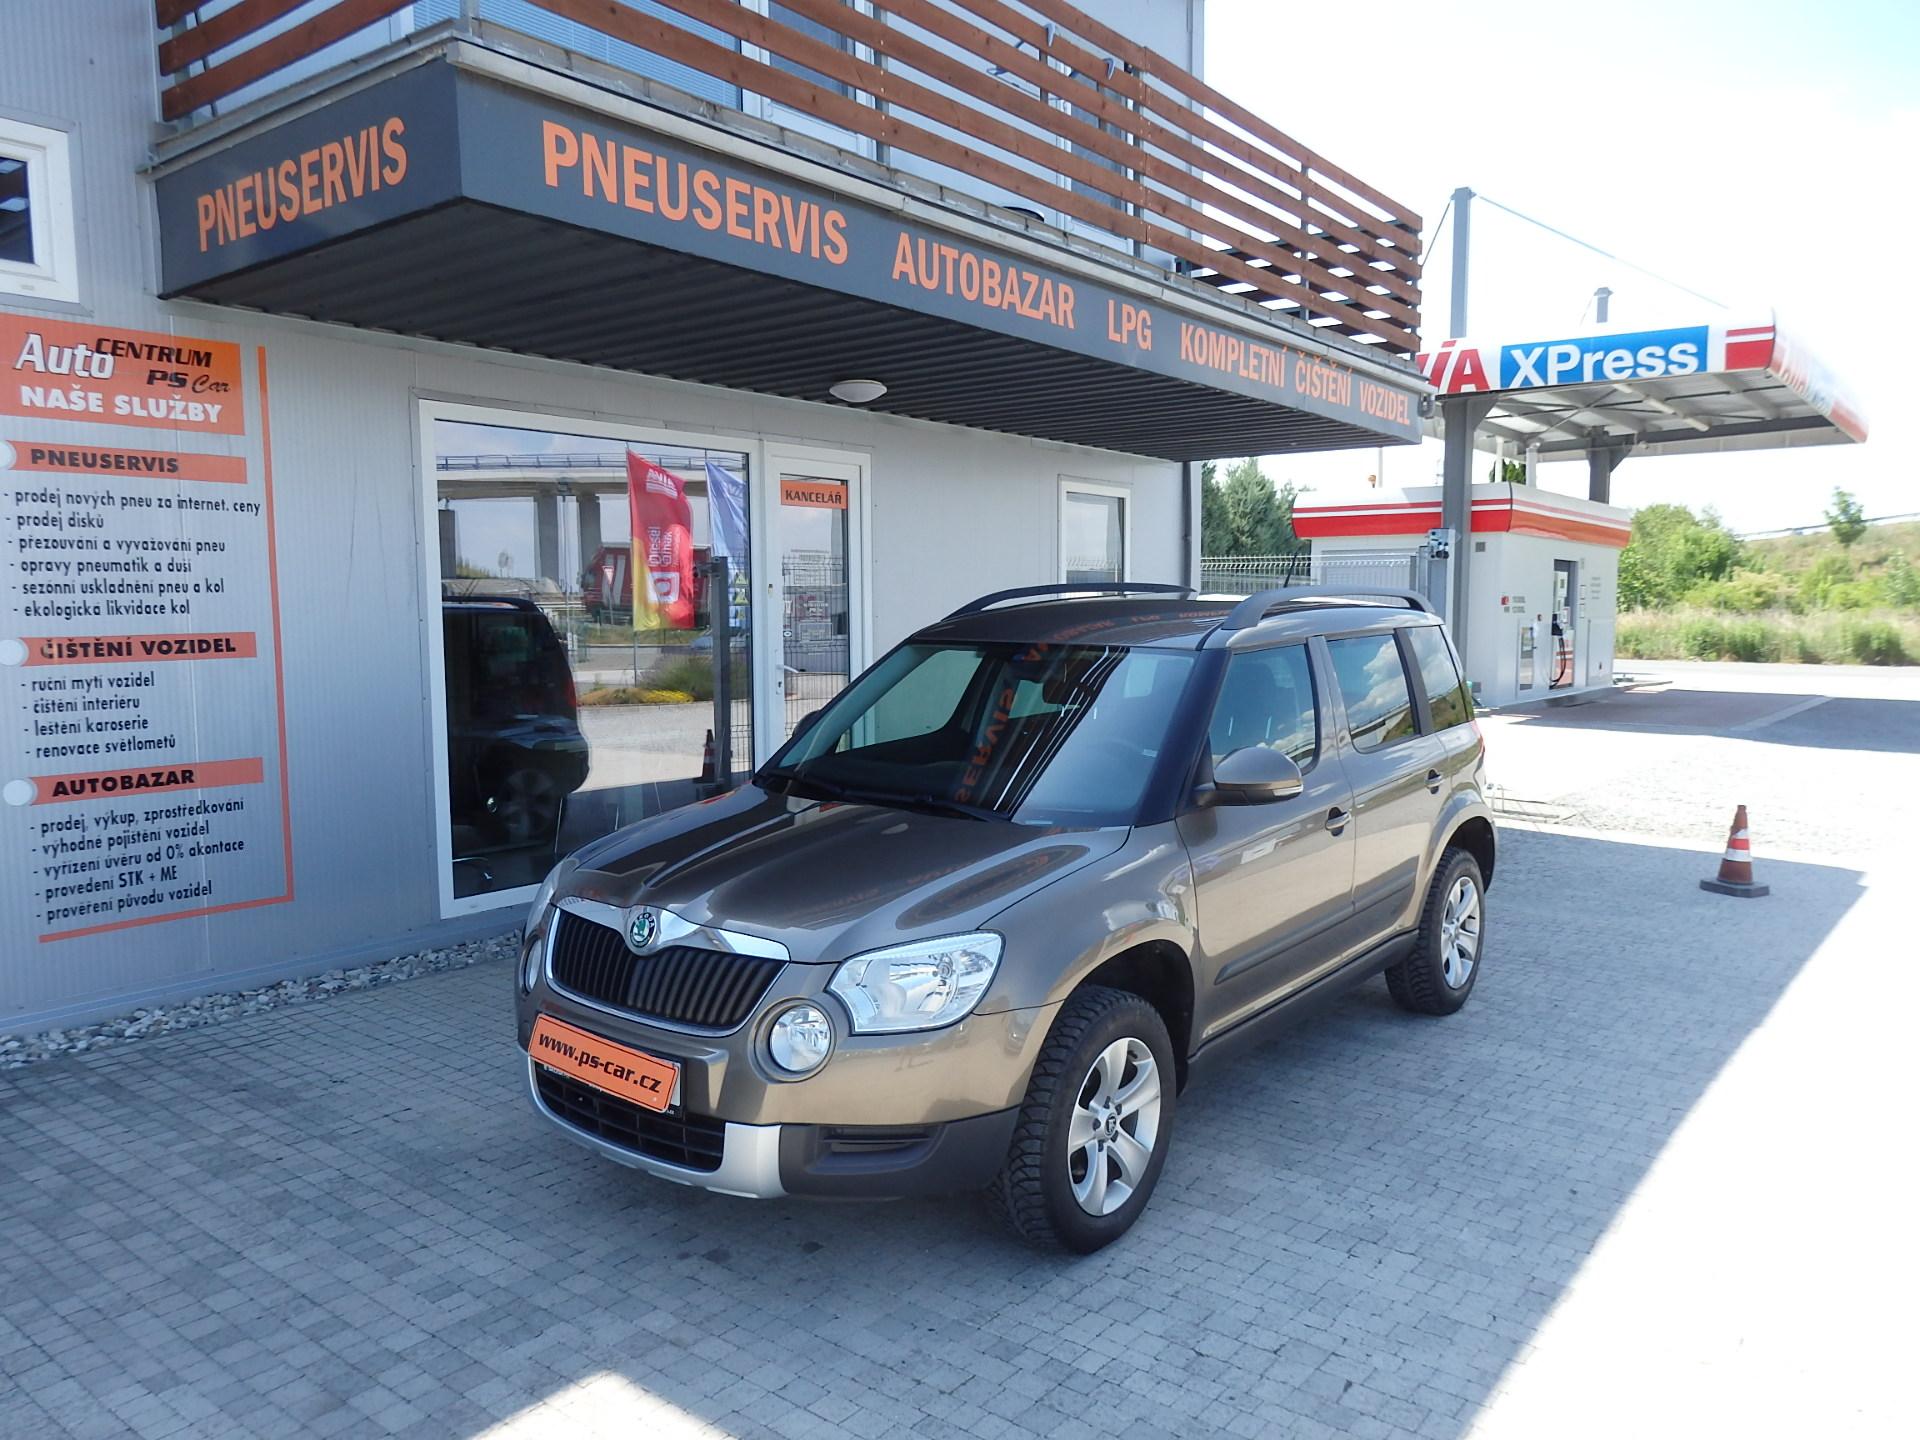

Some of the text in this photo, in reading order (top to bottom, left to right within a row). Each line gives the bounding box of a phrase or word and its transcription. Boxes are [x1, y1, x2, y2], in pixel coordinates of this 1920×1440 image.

[197, 116, 408, 252] PNEUSERVIS
[542, 119, 1410, 425] PNEUSERVIS AUTOBAZAR LPG KOMPLETNÍ ČIŠTĚNÍ VOZIDEL
[13, 332, 212, 380] Auto CENTRUM
[1508, 342, 1700, 389] XPress
[146, 369, 230, 394] PS Car
[20, 383, 223, 423] NAŠE SLUŽBY
[31, 448, 180, 473] PNEUSERVIS
[15, 487, 261, 516] prodej nových pneu za internet. ceny
[785, 488, 842, 505] KANCELÁŘ
[17, 511, 104, 531] prodej disků
[18, 535, 225, 555] přezouvání a vyvažování pneu
[20, 560, 71, 576] opravy
[77, 556, 149, 576] pneumatik
[154, 562, 162, 572] a
[22, 577, 225, 597] sezónní uskladnění pneu a kol
[24, 598, 190, 620] ekologická likvidace kol
[40, 637, 236, 659] ČIŠTĚNÍ VOZIDEL
[32, 670, 155, 693] ruční mytí vozidel
[33, 694, 140, 713] čištění interiéru
[34, 714, 149, 736] leštění karoserie
[36, 734, 176, 758] renovace světlometů
[52, 769, 195, 797] AUTOBAZAR
[144, 797, 244, 824] zprostředkování
[42, 820, 210, 859] výhodné pojištění vozidel
[44, 840, 245, 880] vyřízení úvěru od 0% akontace
[45, 876, 114, 904] provedení
[118, 870, 144, 888] STK
[160, 865, 178, 882] ME
[47, 879, 212, 925] prověření původu vozidel
[538, 1032, 663, 1094] www.ps-car.cz
